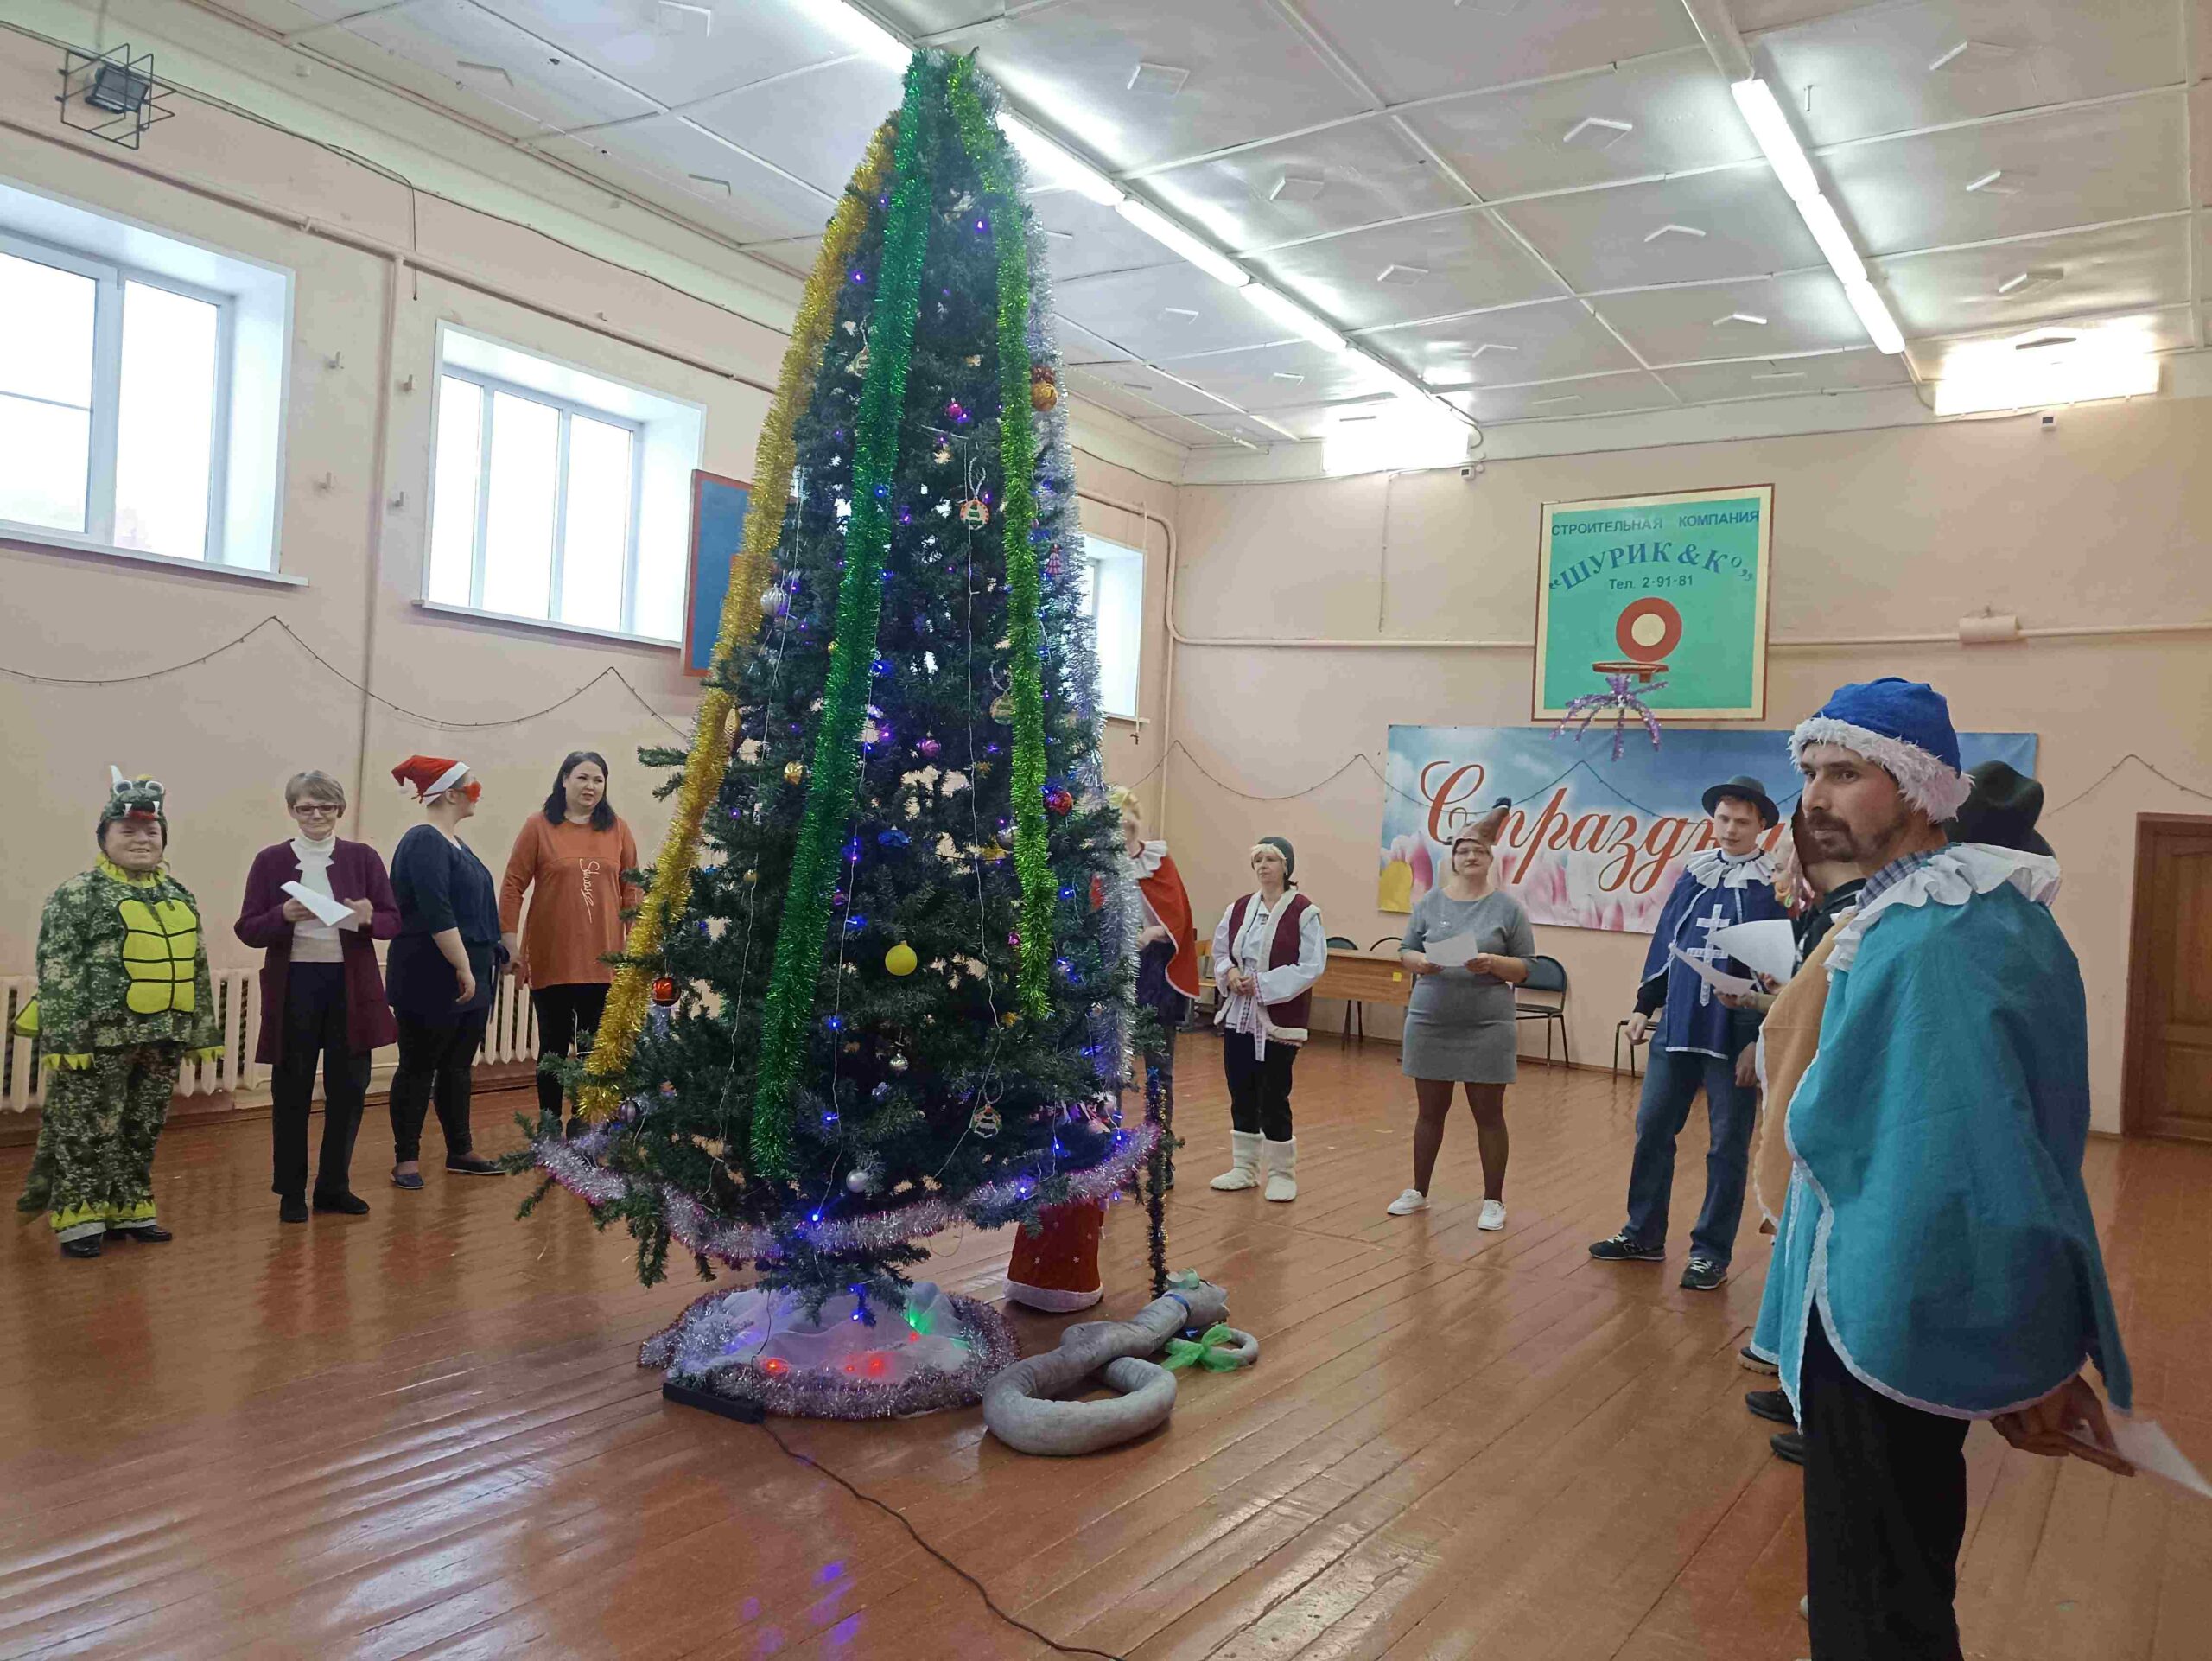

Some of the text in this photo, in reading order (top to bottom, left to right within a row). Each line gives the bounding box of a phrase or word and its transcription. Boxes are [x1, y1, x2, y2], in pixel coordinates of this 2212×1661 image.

[1551, 510, 1759, 536] СТРОИТЕЛЬНАЯ КОМПАНИЯ
[1609, 575, 1693, 590] Тел. 2-91-81
[1420, 760, 1485, 847] С
